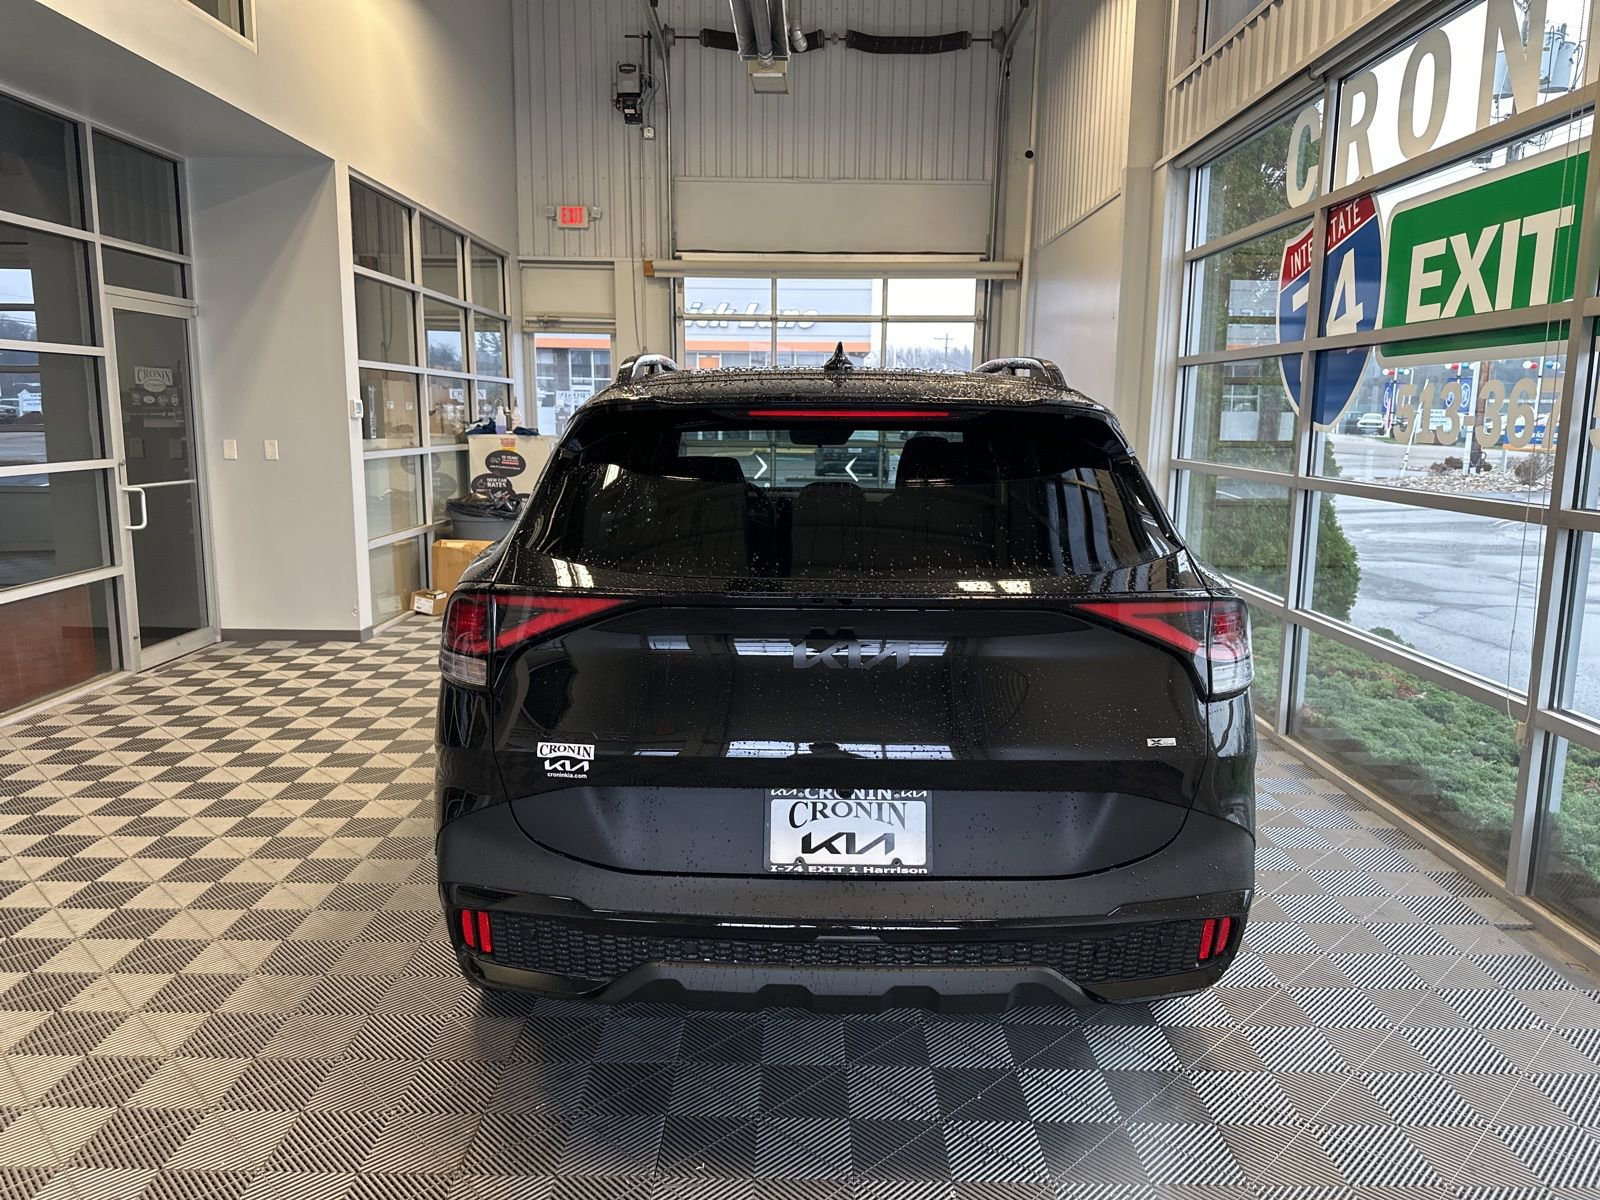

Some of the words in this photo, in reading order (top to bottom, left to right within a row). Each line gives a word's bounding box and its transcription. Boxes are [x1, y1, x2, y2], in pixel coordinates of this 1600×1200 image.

[561, 207, 583, 224] EXIT
[1290, 197, 1361, 278] INTETATE
[1405, 205, 1576, 323] EXIT
[793, 640, 910, 670] KIA
[539, 743, 592, 759] CRONIN
[544, 759, 589, 772] KIA
[771, 788, 797, 796] KIA
[901, 789, 928, 798] KIA
[788, 801, 908, 830] CRONIN
[802, 832, 896, 856] KIA
[770, 865, 804, 873] I-74
[808, 865, 845, 873] EXIT
[863, 865, 928, 875] Harrison
